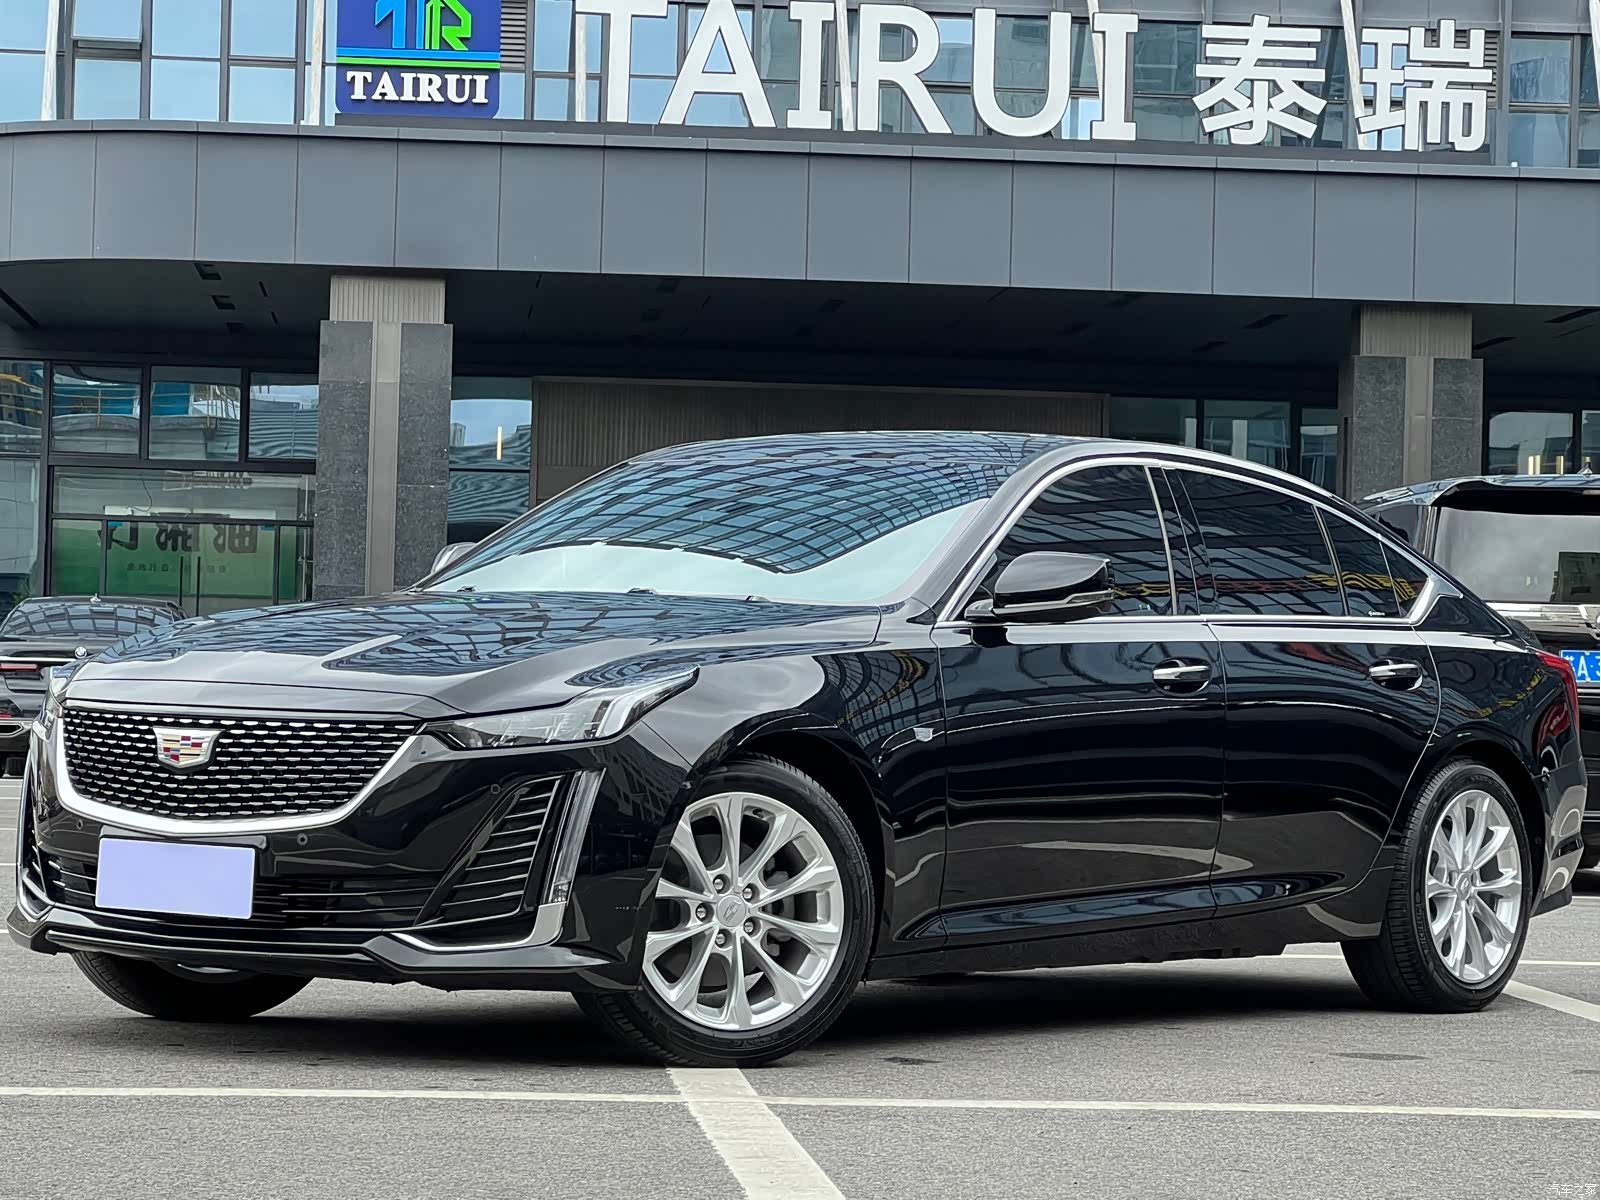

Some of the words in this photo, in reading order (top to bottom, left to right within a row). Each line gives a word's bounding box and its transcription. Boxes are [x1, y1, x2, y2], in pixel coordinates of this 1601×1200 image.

[346, 71, 490, 104] TAIRUI
[576, 0, 1139, 141] TAIRUI
[1192, 14, 1493, 151] 泰瑞
